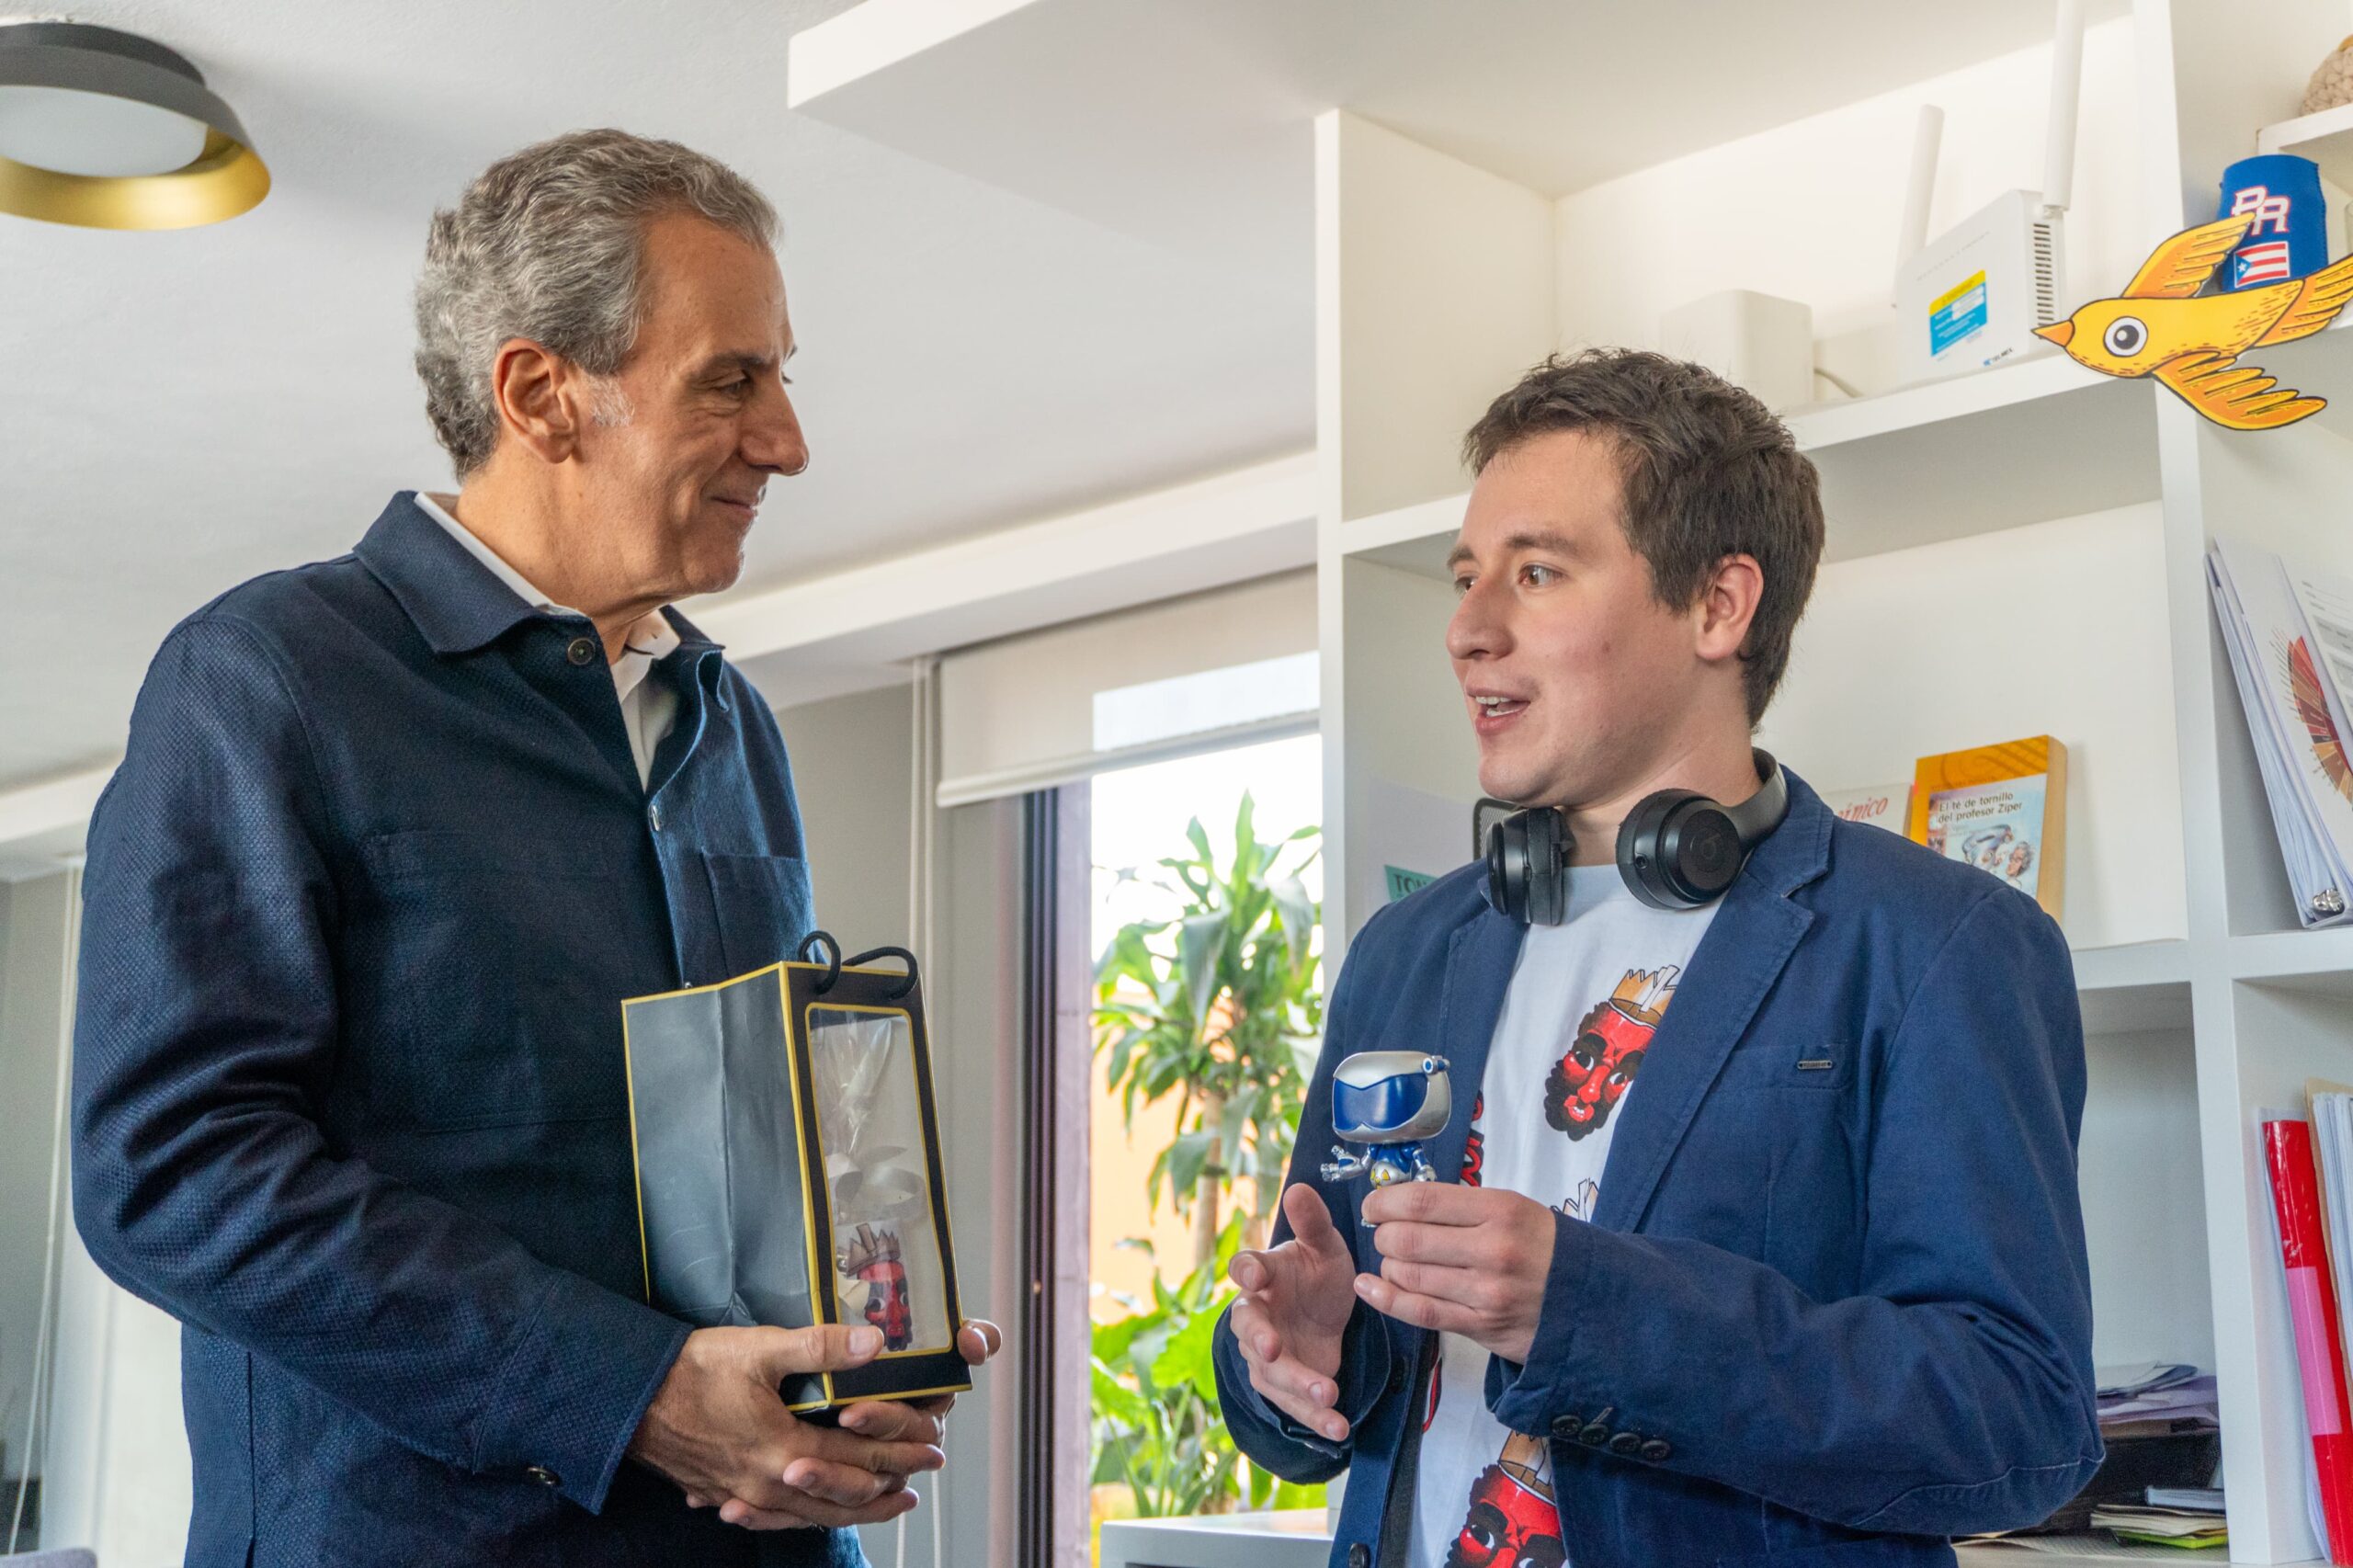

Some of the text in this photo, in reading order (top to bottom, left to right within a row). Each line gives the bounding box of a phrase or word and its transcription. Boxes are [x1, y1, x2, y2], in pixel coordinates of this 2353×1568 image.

[2231, 185, 2290, 237] PR
[1938, 801, 2023, 824] del profesor Ziper
[1939, 801, 1949, 812] El
[1964, 798, 1976, 808] de
[1980, 790, 2015, 807] tornillo
